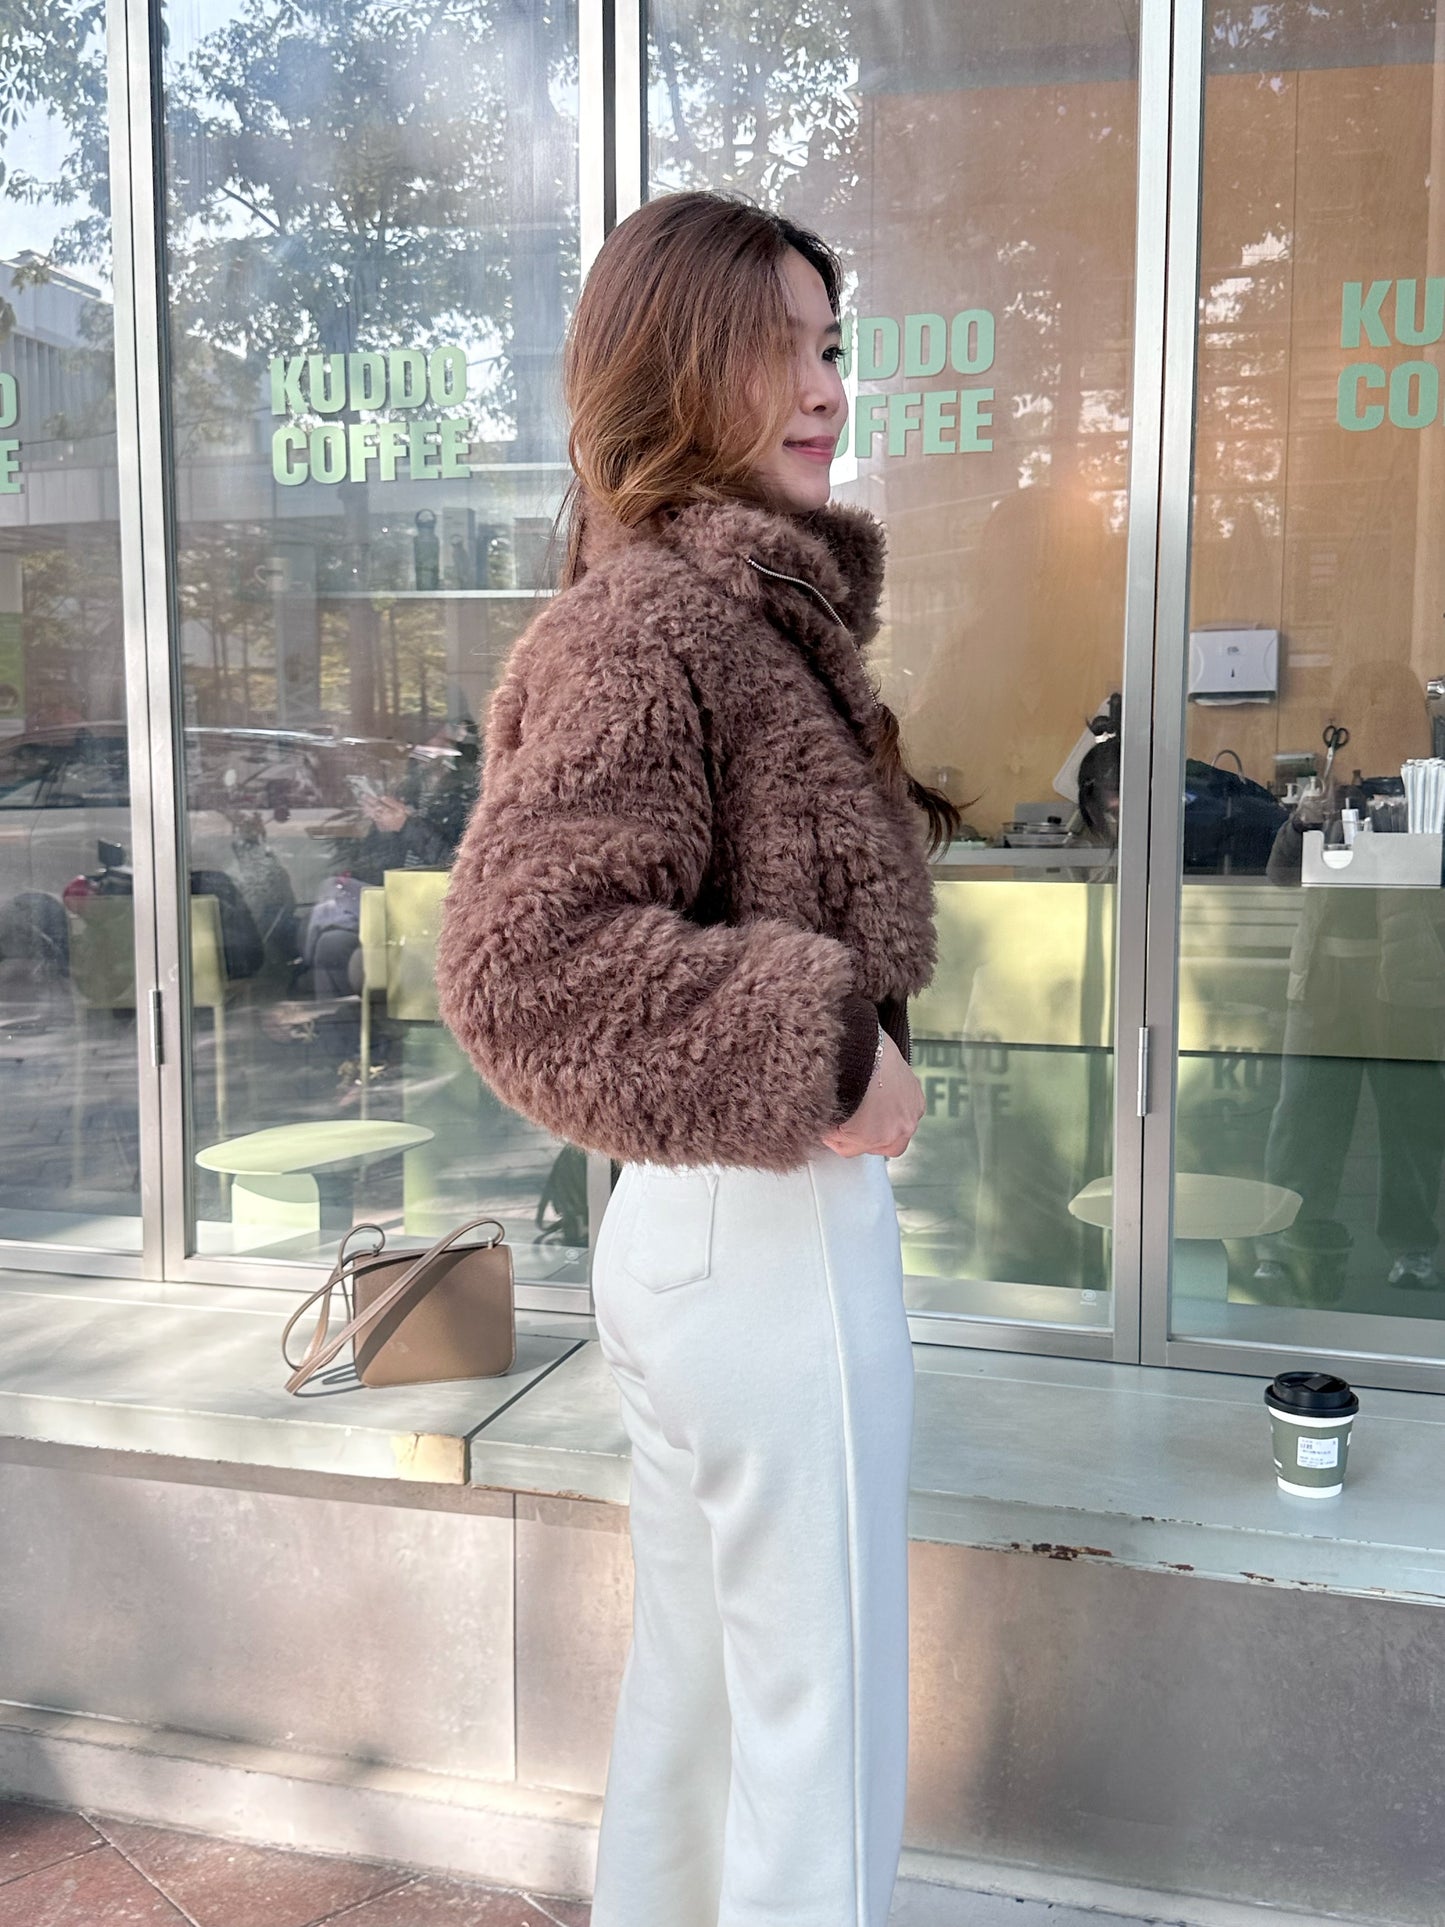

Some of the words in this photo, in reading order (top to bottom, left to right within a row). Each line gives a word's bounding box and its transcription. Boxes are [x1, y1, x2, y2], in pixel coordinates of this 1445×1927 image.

[837, 309, 995, 381] DDO
[270, 346, 468, 416] KUDDO
[1336, 360, 1445, 432] CO
[272, 419, 471, 486] COFFEE
[834, 388, 995, 459] FFEE
